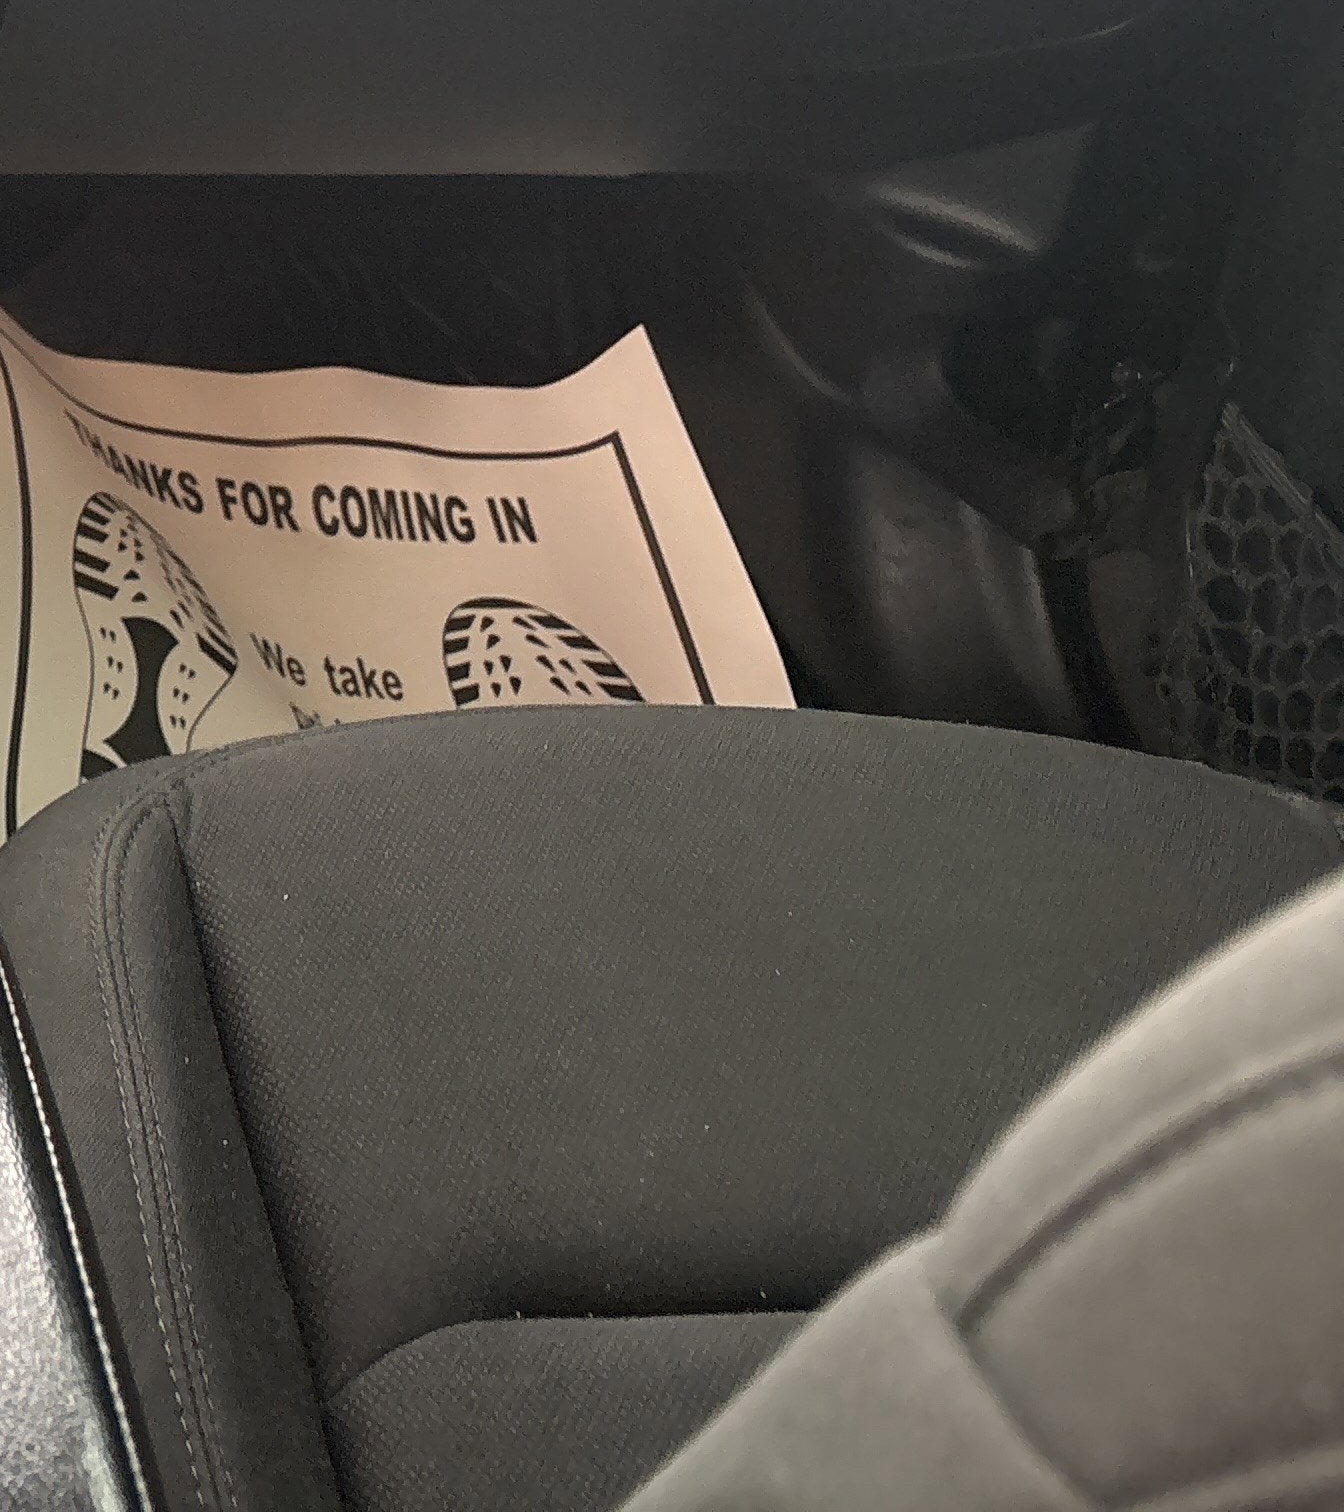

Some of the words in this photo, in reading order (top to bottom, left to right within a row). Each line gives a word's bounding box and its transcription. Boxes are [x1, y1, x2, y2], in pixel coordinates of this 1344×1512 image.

[64, 408, 205, 514] THANKS
[215, 476, 300, 533] FOR
[311, 483, 477, 544] COMING
[487, 494, 539, 544] IN
[249, 632, 307, 687] We
[323, 654, 405, 702] take
